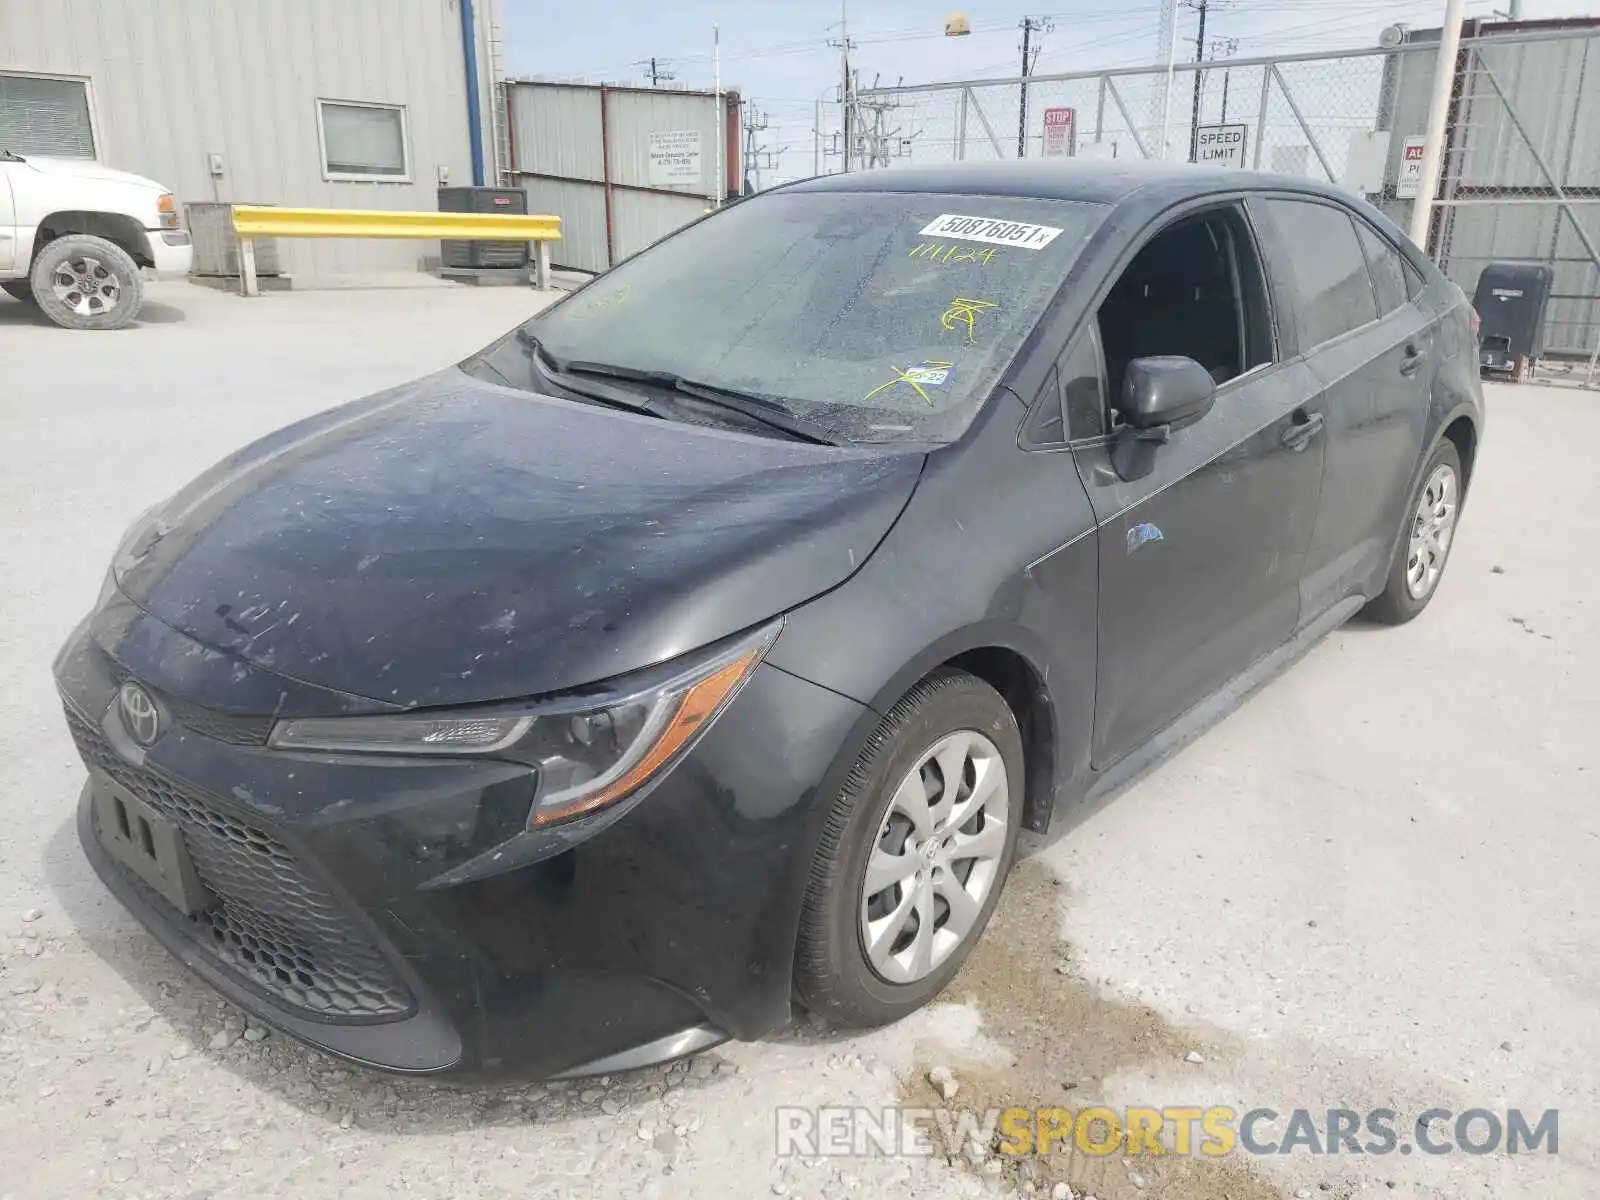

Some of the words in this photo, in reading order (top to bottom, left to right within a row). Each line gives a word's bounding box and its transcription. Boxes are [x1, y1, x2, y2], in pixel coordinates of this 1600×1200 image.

[1046, 111, 1070, 122] STOP
[1200, 132, 1241, 144] SPEED
[1203, 148, 1236, 160] LIMIT
[940, 217, 1041, 243] 50876051
